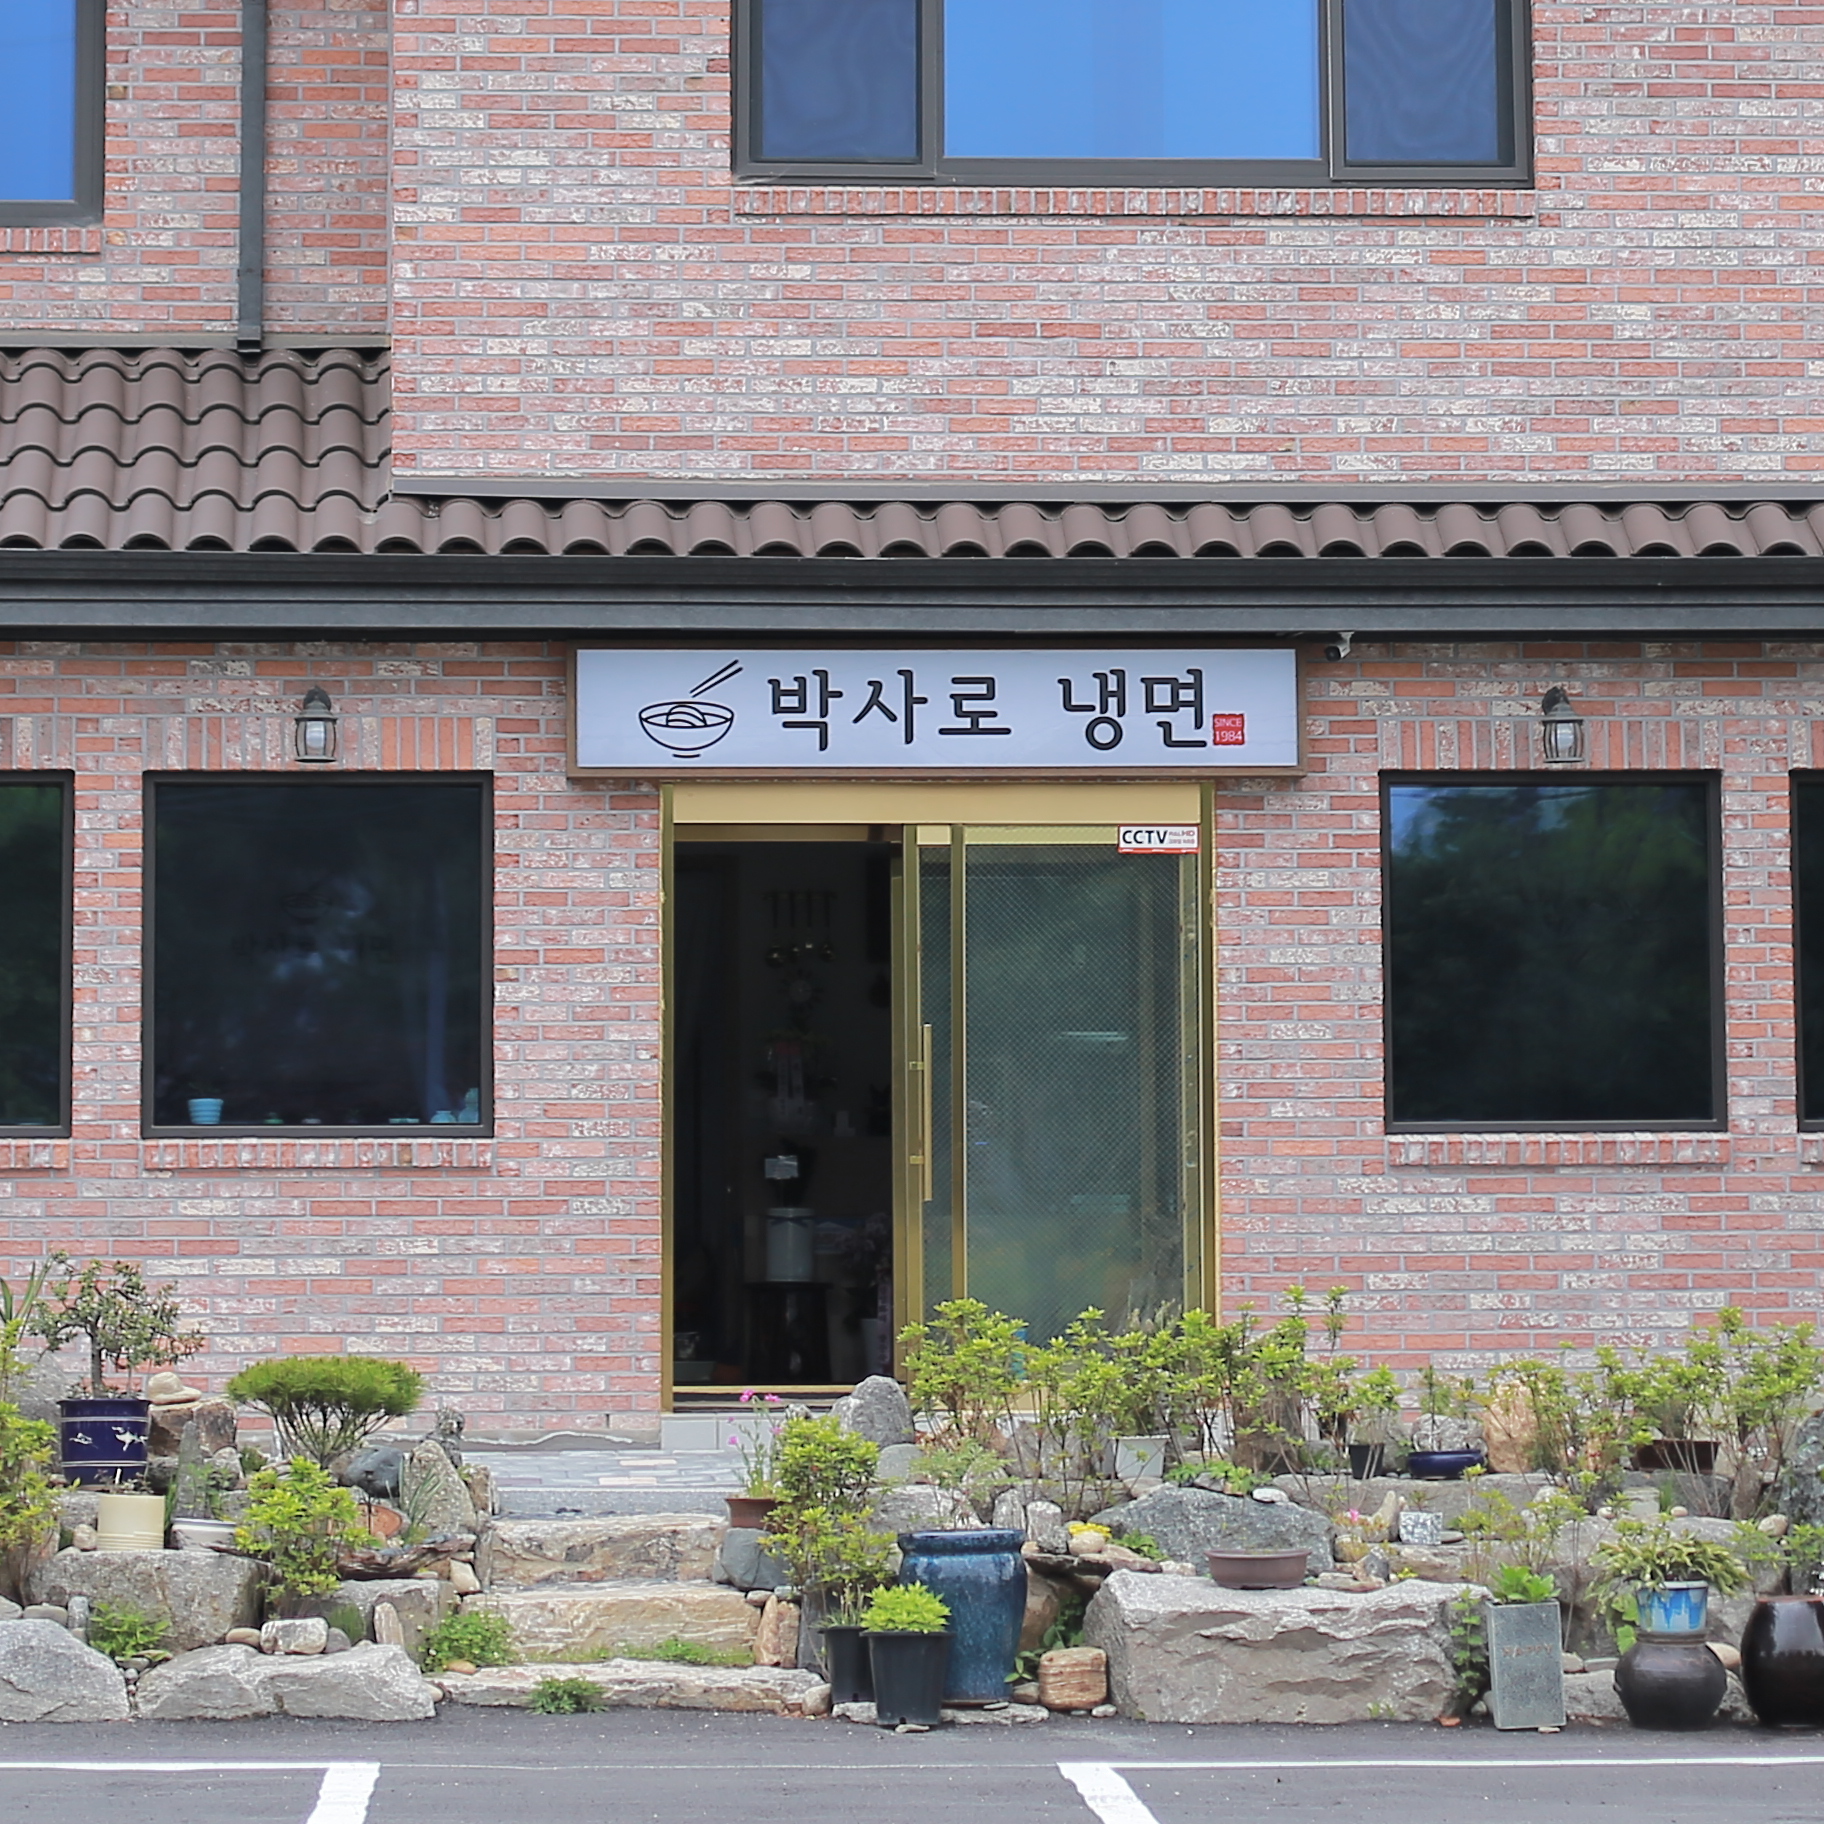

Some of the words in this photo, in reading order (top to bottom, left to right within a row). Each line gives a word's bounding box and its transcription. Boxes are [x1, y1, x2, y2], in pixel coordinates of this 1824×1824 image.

[767, 669, 1012, 752] 박사로
[1057, 668, 1208, 751] 냉면
[1214, 717, 1242, 727] SINCE
[1215, 730, 1243, 742] 1984
[1122, 829, 1168, 845] CCTV
